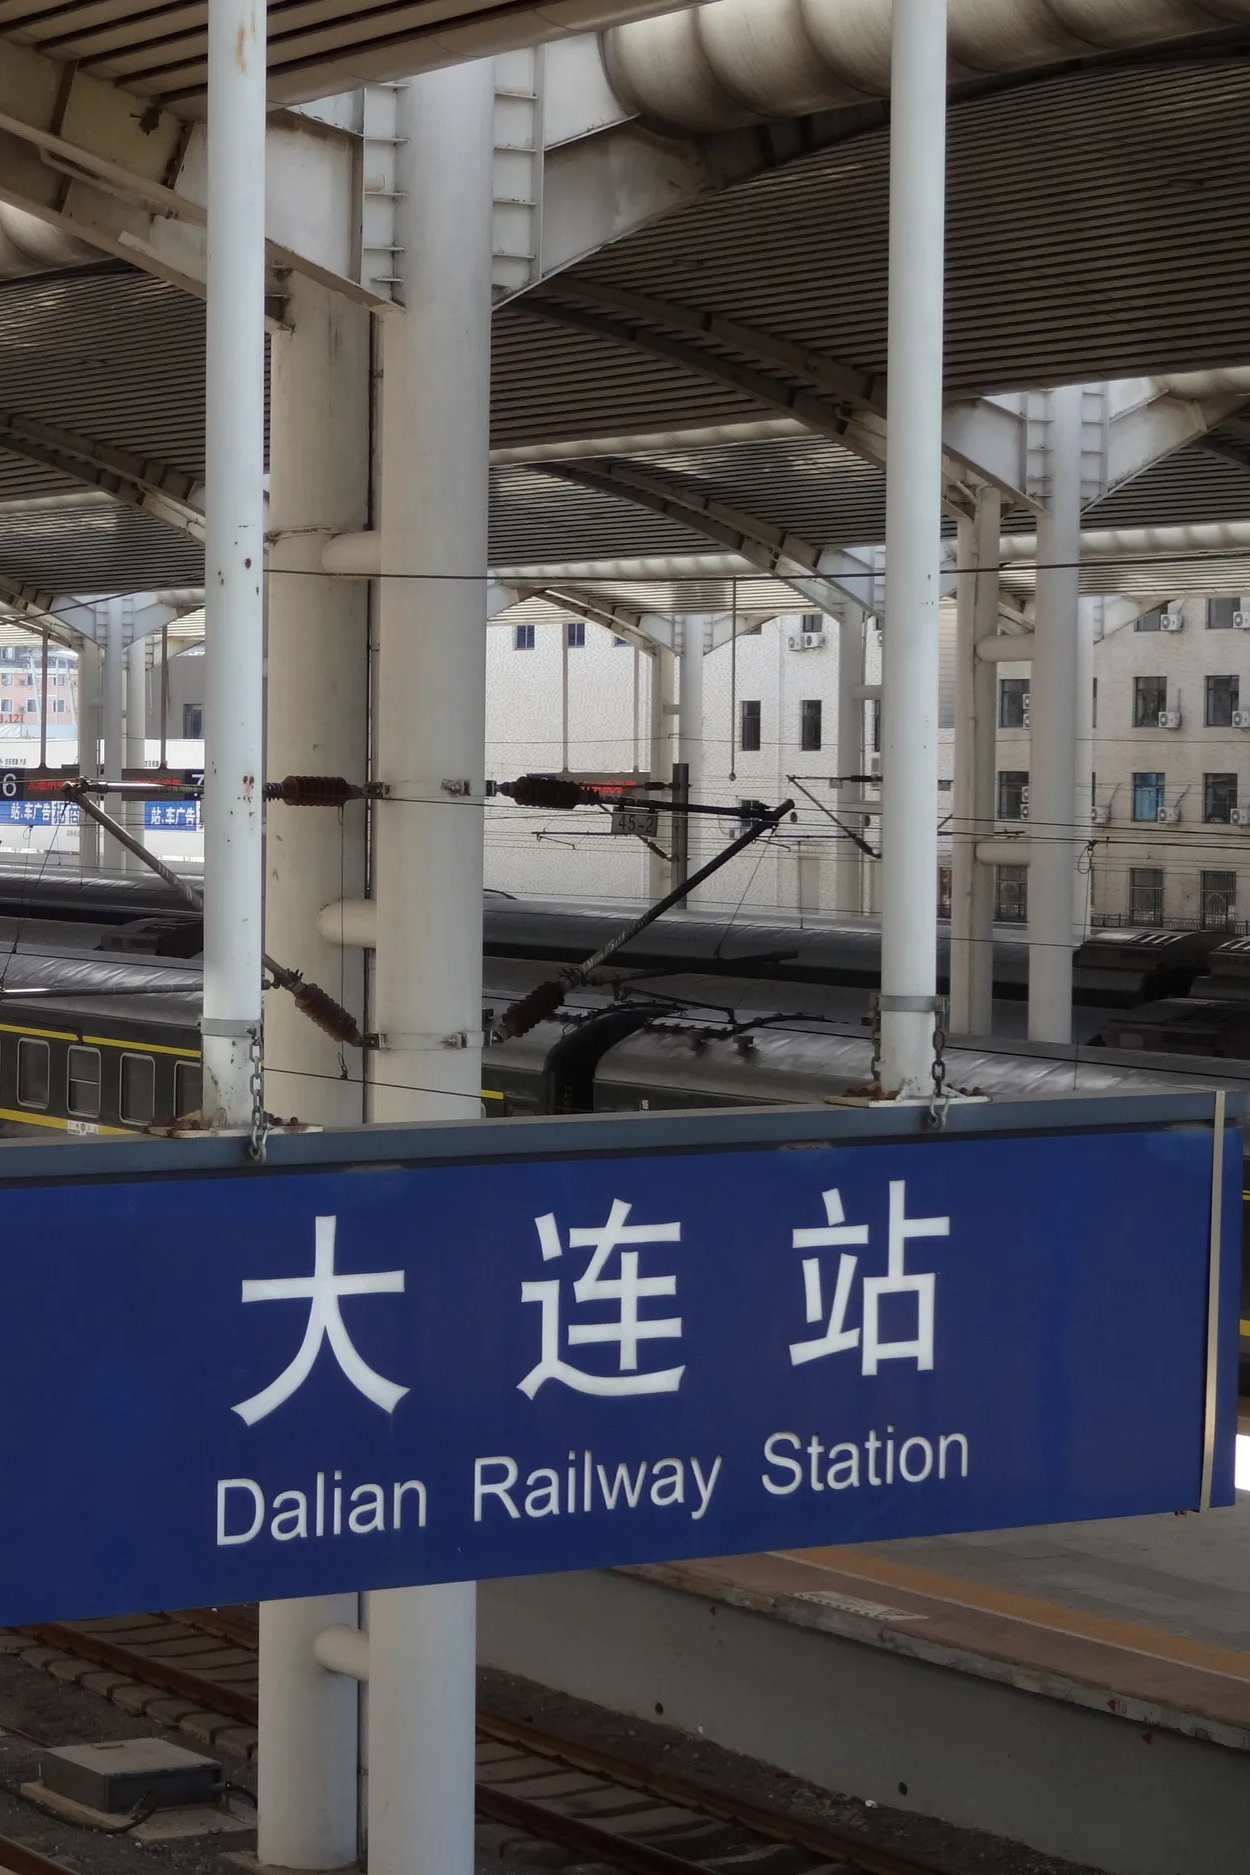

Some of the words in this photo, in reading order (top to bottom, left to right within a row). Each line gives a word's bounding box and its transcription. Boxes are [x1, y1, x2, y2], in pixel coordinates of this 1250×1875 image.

[2, 773, 17, 797] 6
[216, 1470, 427, 1546] Dalian
[473, 1449, 722, 1521] Railway
[761, 1425, 969, 1496] Station
